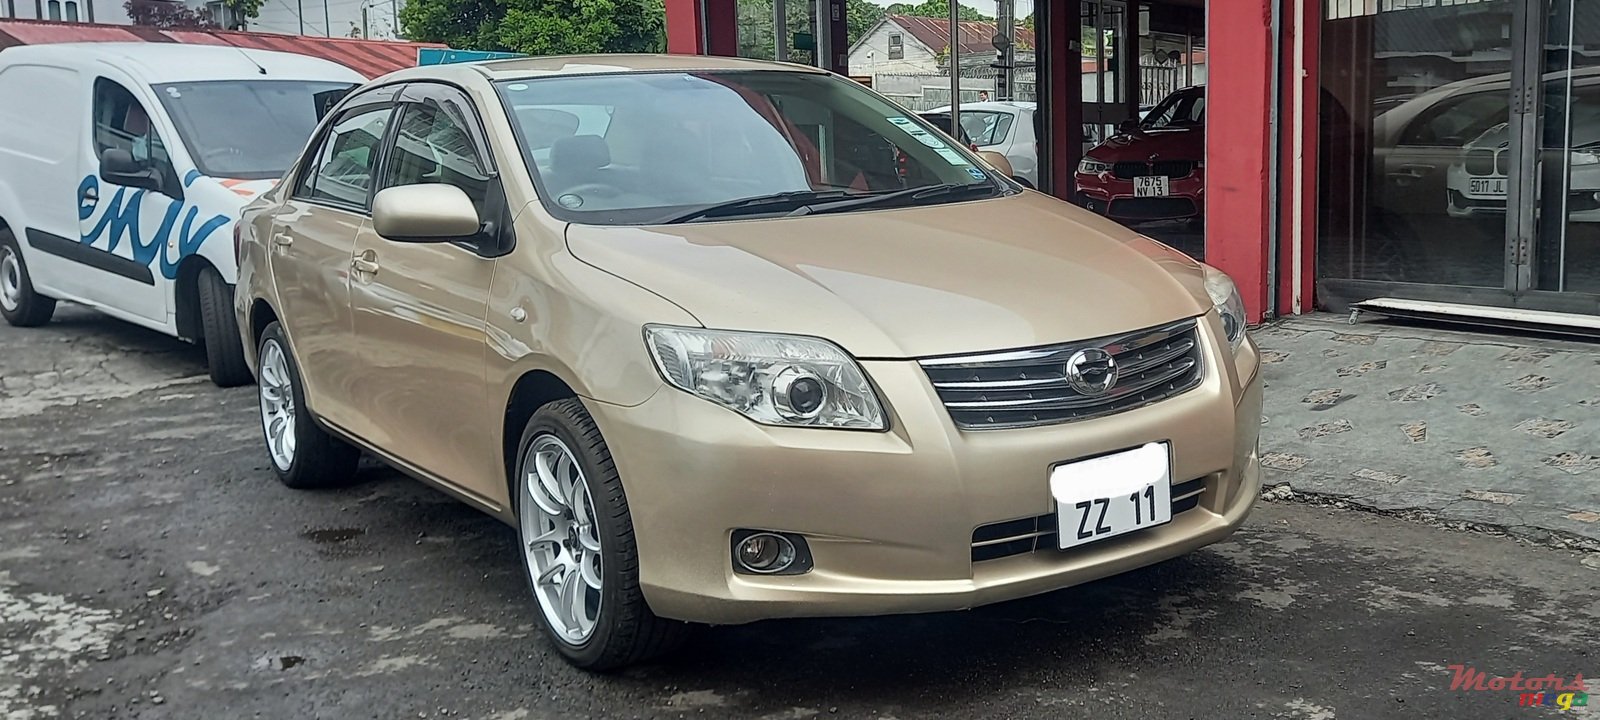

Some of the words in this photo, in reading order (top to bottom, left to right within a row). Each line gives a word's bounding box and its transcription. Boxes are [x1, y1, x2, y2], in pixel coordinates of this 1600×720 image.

[1139, 177, 1162, 187] 7675
[1471, 180, 1489, 192] 5017
[1493, 180, 1504, 192] JL
[1137, 187, 1148, 196] NV
[1153, 187, 1163, 196] 13
[1075, 498, 1111, 540] ZZ
[1129, 485, 1156, 525] 11
